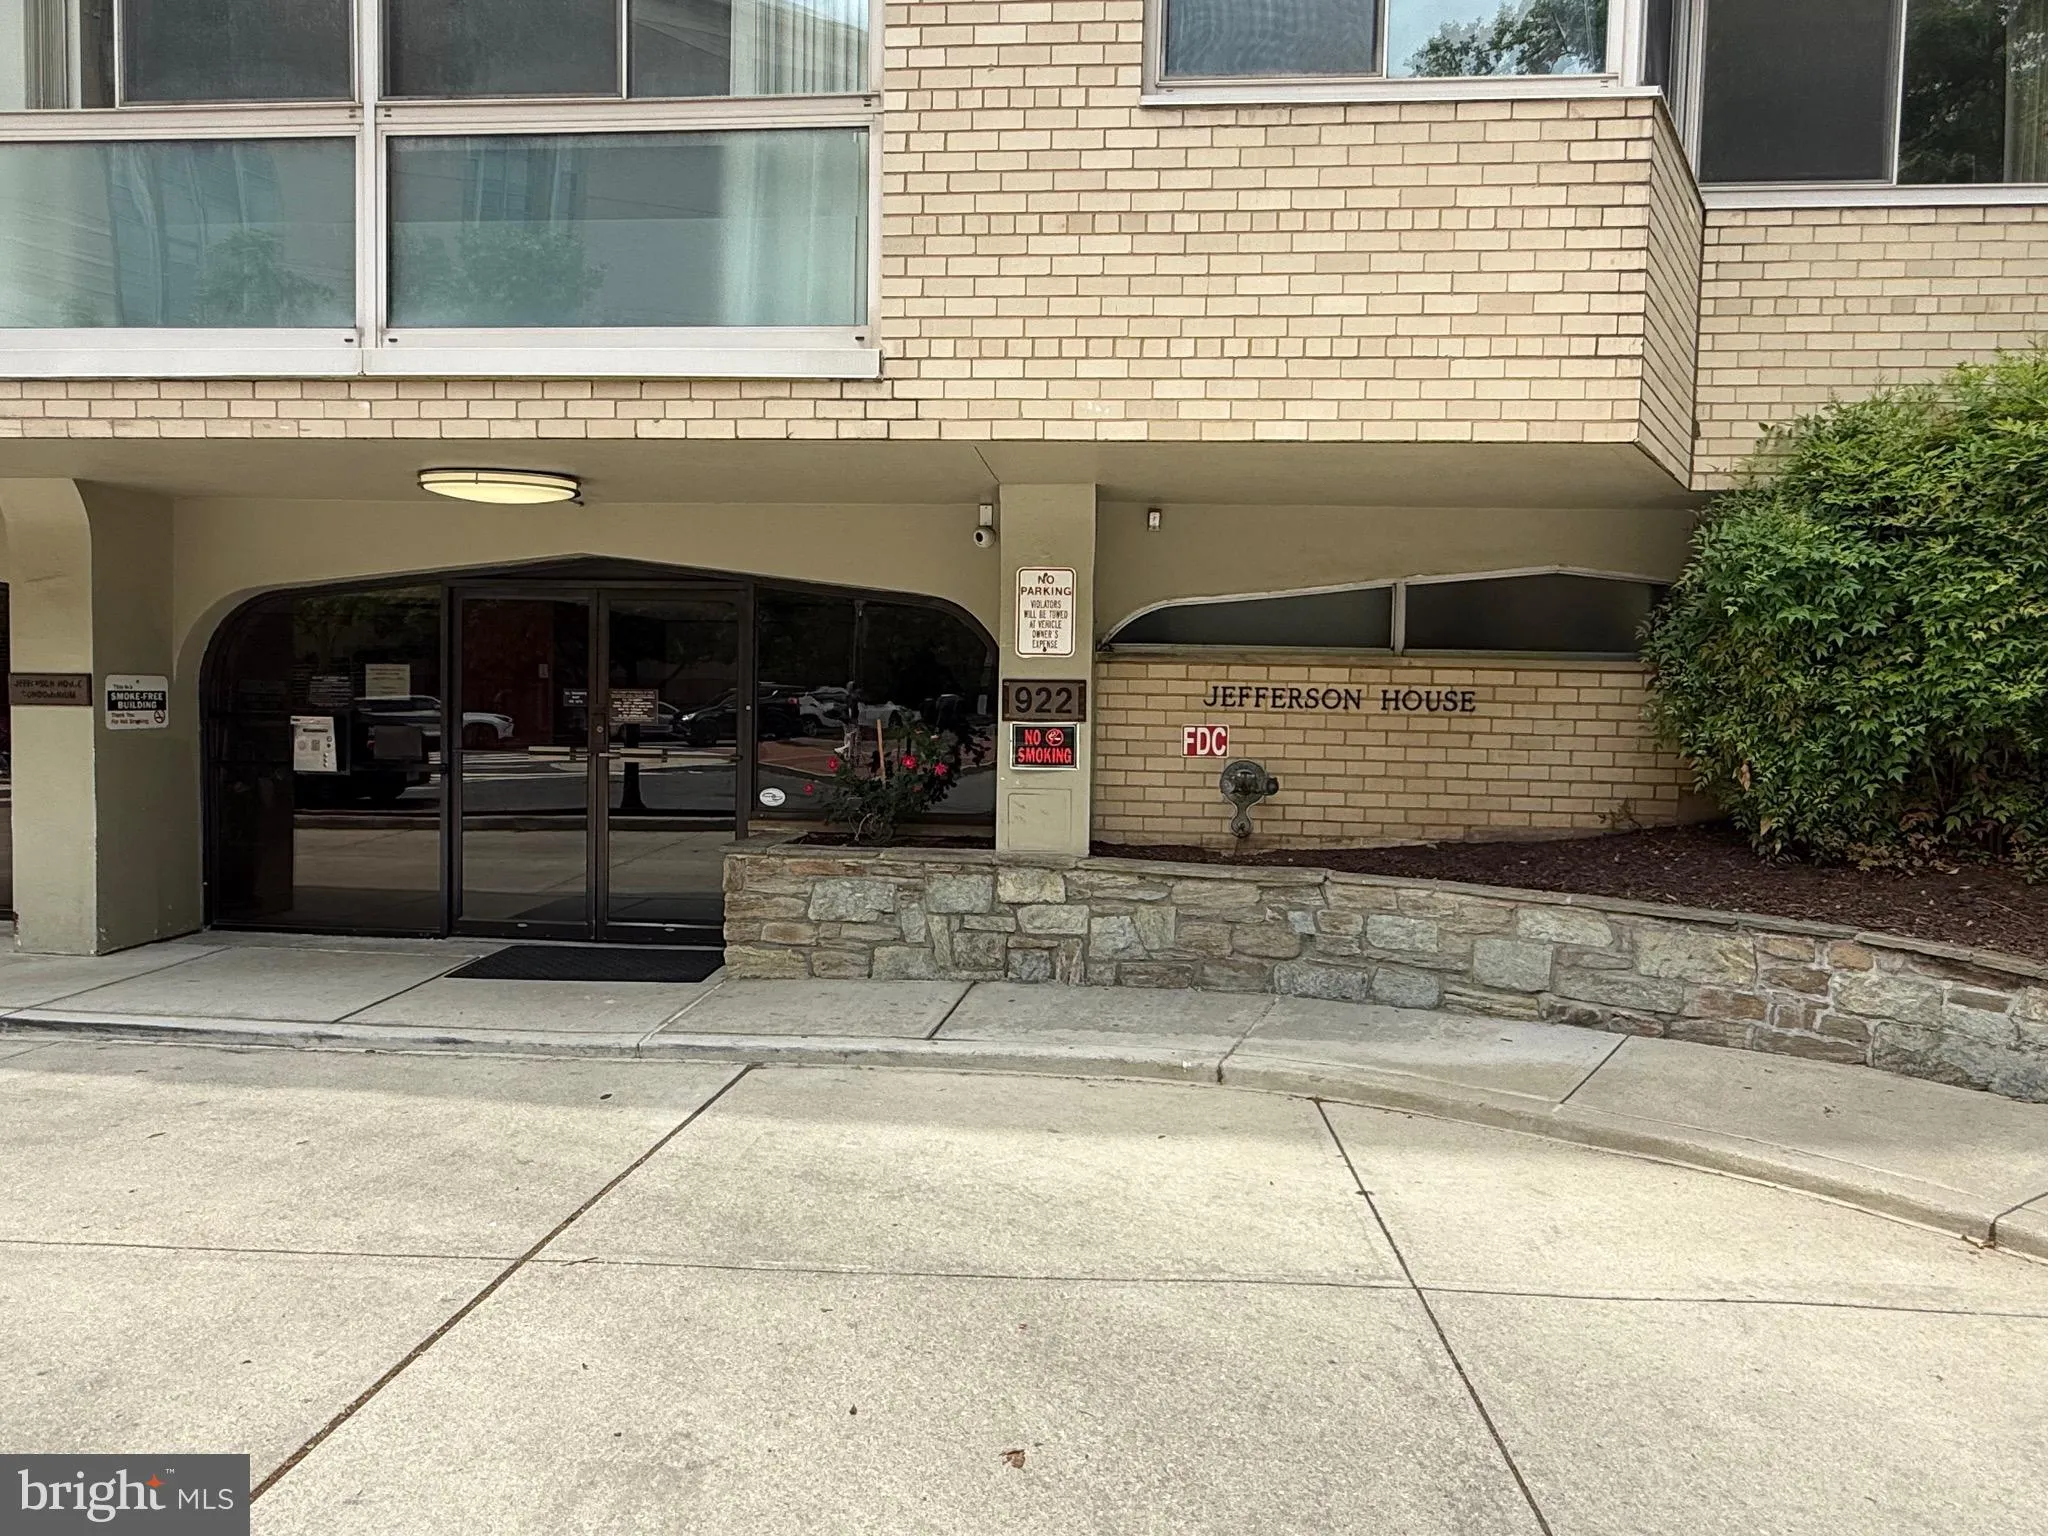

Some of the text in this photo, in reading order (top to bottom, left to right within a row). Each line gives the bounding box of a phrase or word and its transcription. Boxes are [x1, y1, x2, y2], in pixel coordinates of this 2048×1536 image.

[1038, 575, 1055, 584] NO
[1020, 586, 1072, 596] PARKING
[1031, 600, 1062, 608] VIOLATORS
[1024, 610, 1068, 619] WILL BE TOWED
[1029, 620, 1062, 629] AT VEHICLE
[1032, 630, 1059, 639] OWNER'S
[1032, 640, 1058, 649] EXPENSE
[110, 691, 164, 701] SMOKE-FREE
[1015, 686, 1073, 714] 922
[1203, 686, 1476, 712] JEFFERSON HOUSE
[117, 701, 158, 709] BUILDING
[1024, 729, 1041, 745] NO
[1183, 727, 1227, 755] FDC
[1018, 747, 1073, 764] SMOKING
